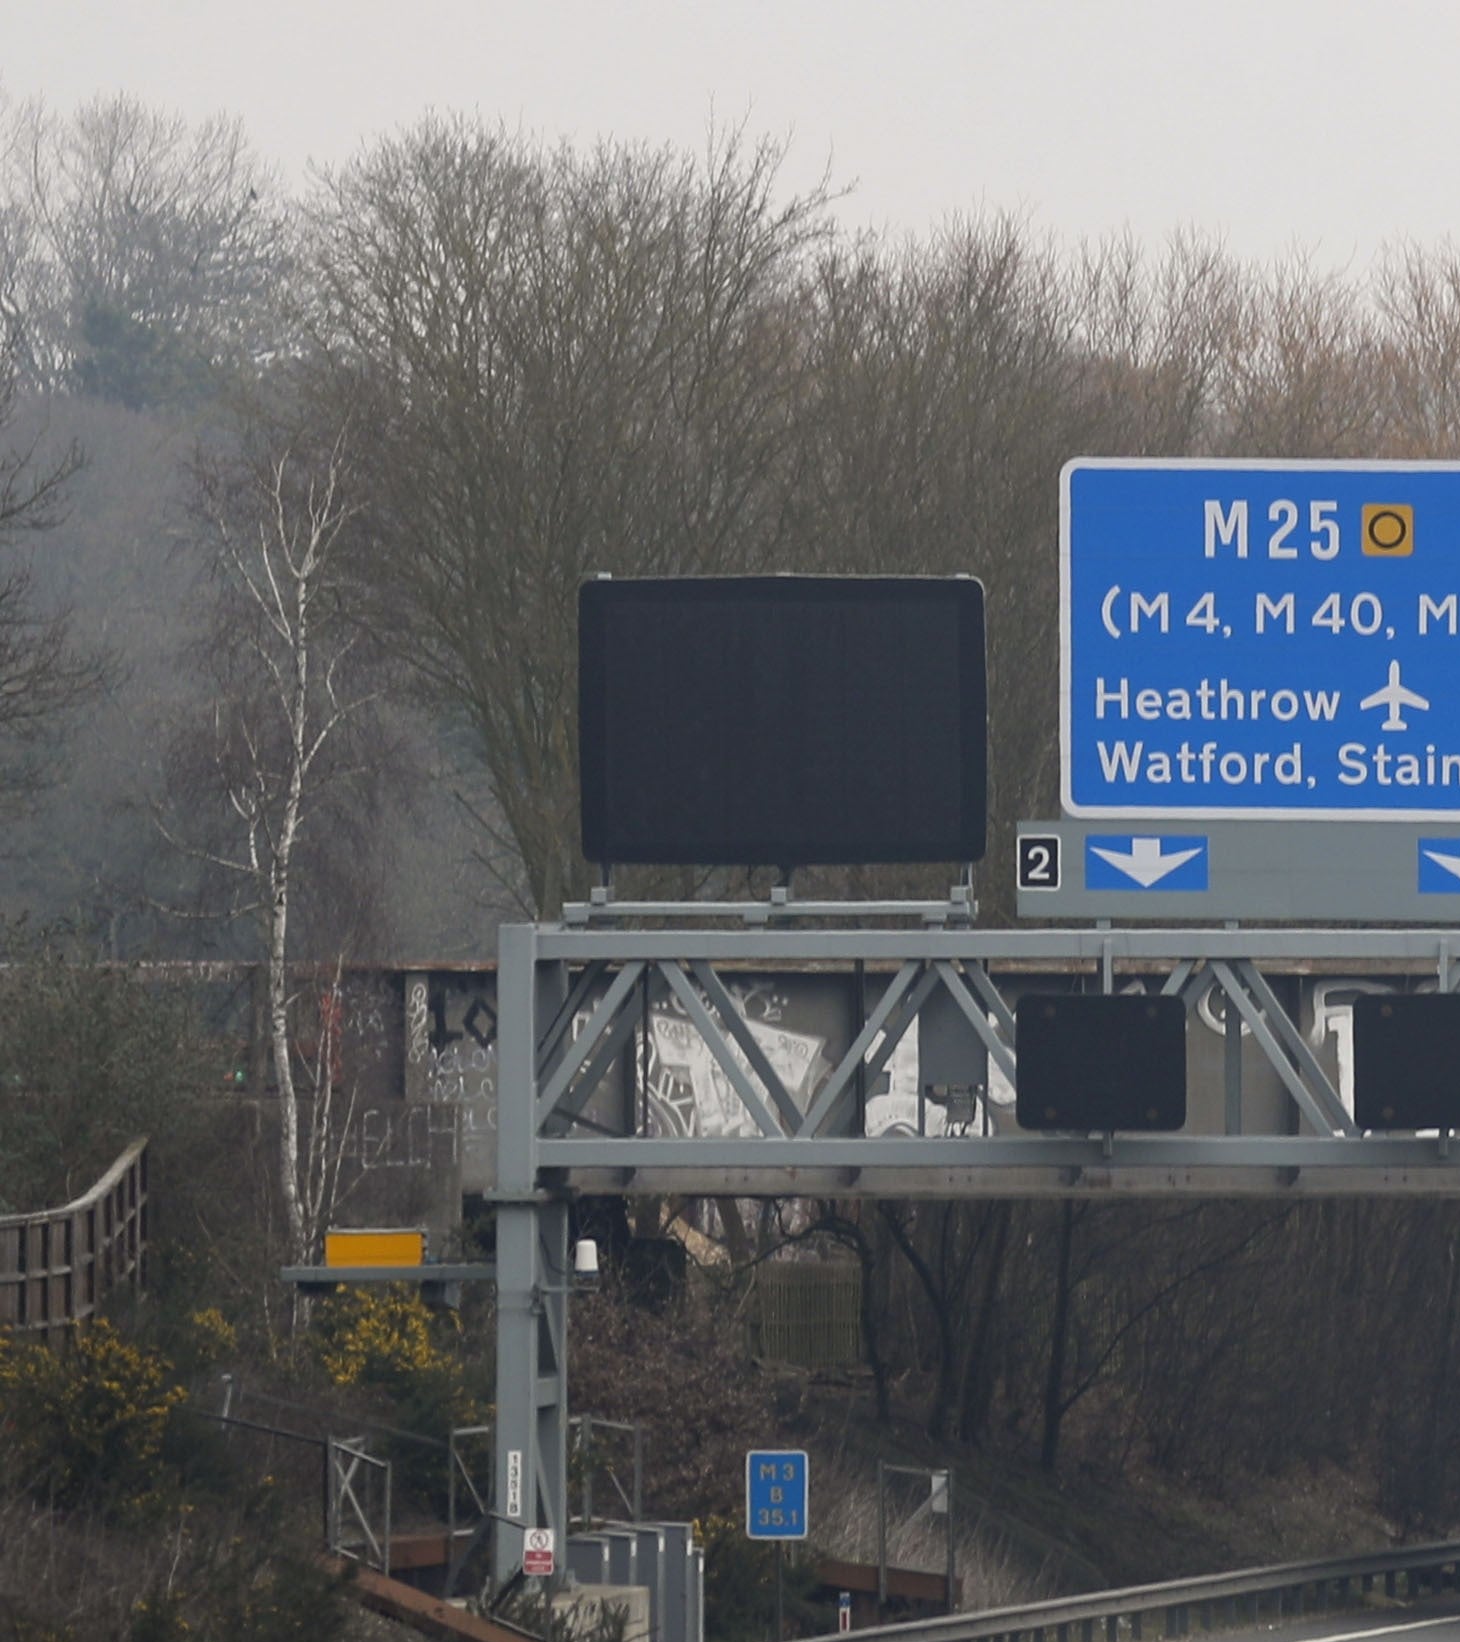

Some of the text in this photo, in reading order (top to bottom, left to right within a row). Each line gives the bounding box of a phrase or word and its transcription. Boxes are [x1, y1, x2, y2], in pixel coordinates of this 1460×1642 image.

[1096, 677, 1341, 722] Heathrow
[1097, 742, 1317, 790] Watford,
[1028, 846, 1050, 879] 2
[770, 1486, 783, 1503] B
[758, 1508, 798, 1527] 35.1
